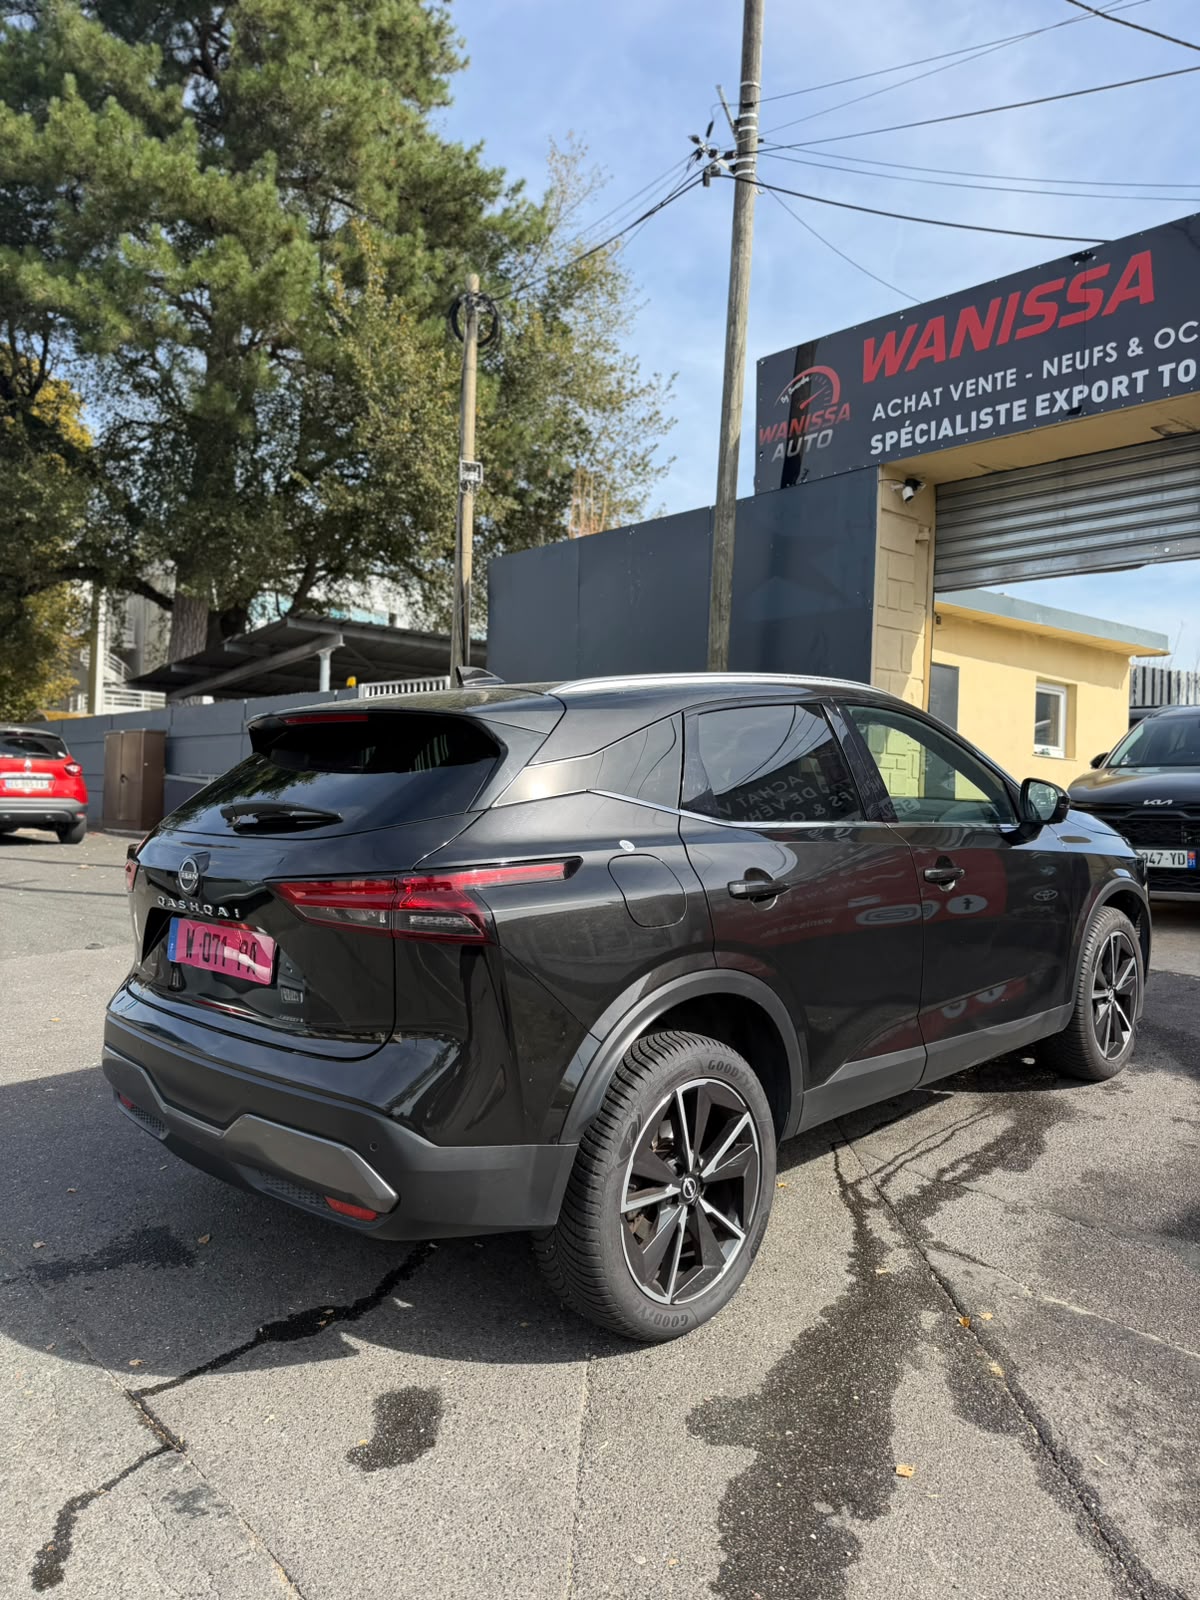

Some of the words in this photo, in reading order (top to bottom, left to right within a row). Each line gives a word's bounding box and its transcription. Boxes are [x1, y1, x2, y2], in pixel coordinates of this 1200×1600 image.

[862, 249, 1155, 384] WANISSA
[869, 398, 1028, 455] SPÉCIALISTE
[1035, 368, 1150, 417] EXPORT
[1157, 358, 1198, 388] TO
[872, 387, 943, 422] ACHAT
[949, 368, 1017, 401] VENTE
[1042, 341, 1118, 380] NEUFS
[1126, 336, 1144, 358] &
[759, 402, 851, 446] WANISSA
[771, 428, 834, 463] AUTO
[157, 895, 240, 918] QASHQAI
